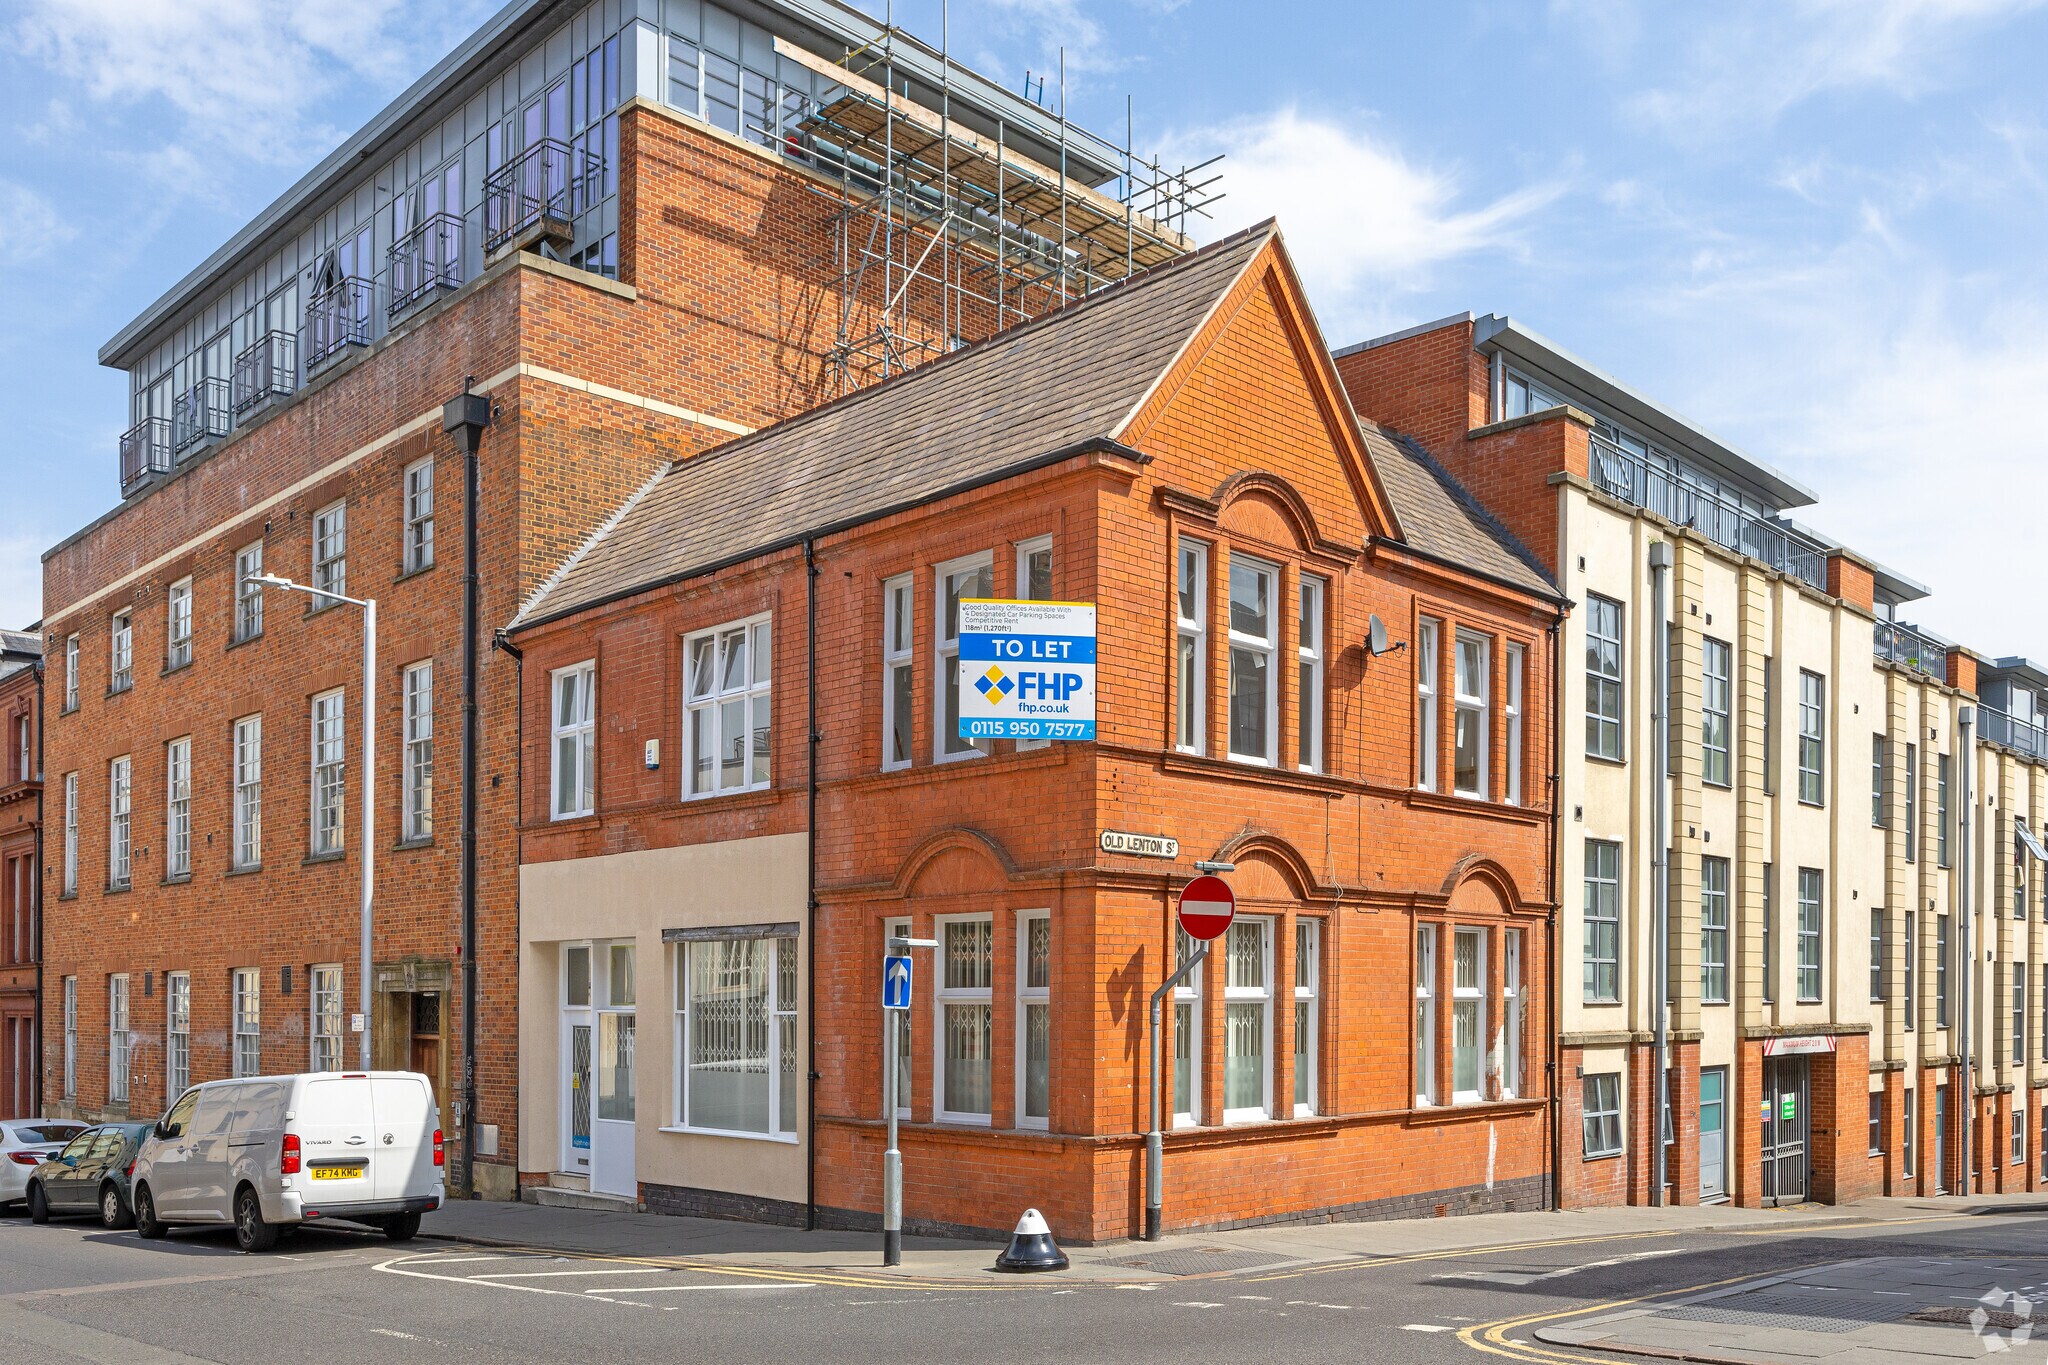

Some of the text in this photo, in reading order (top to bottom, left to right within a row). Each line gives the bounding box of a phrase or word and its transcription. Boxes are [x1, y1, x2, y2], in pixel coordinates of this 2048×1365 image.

[983, 604, 1004, 612] Quality
[992, 639, 1072, 659] TO LET
[1018, 671, 1083, 701] FHP
[1018, 702, 1070, 714] fhp.co.uk
[971, 721, 1085, 737] 0115 950 7577
[1105, 834, 1124, 848] OLD
[1127, 836, 1163, 853] LENTON
[315, 1168, 358, 1178] EF74 KMG
